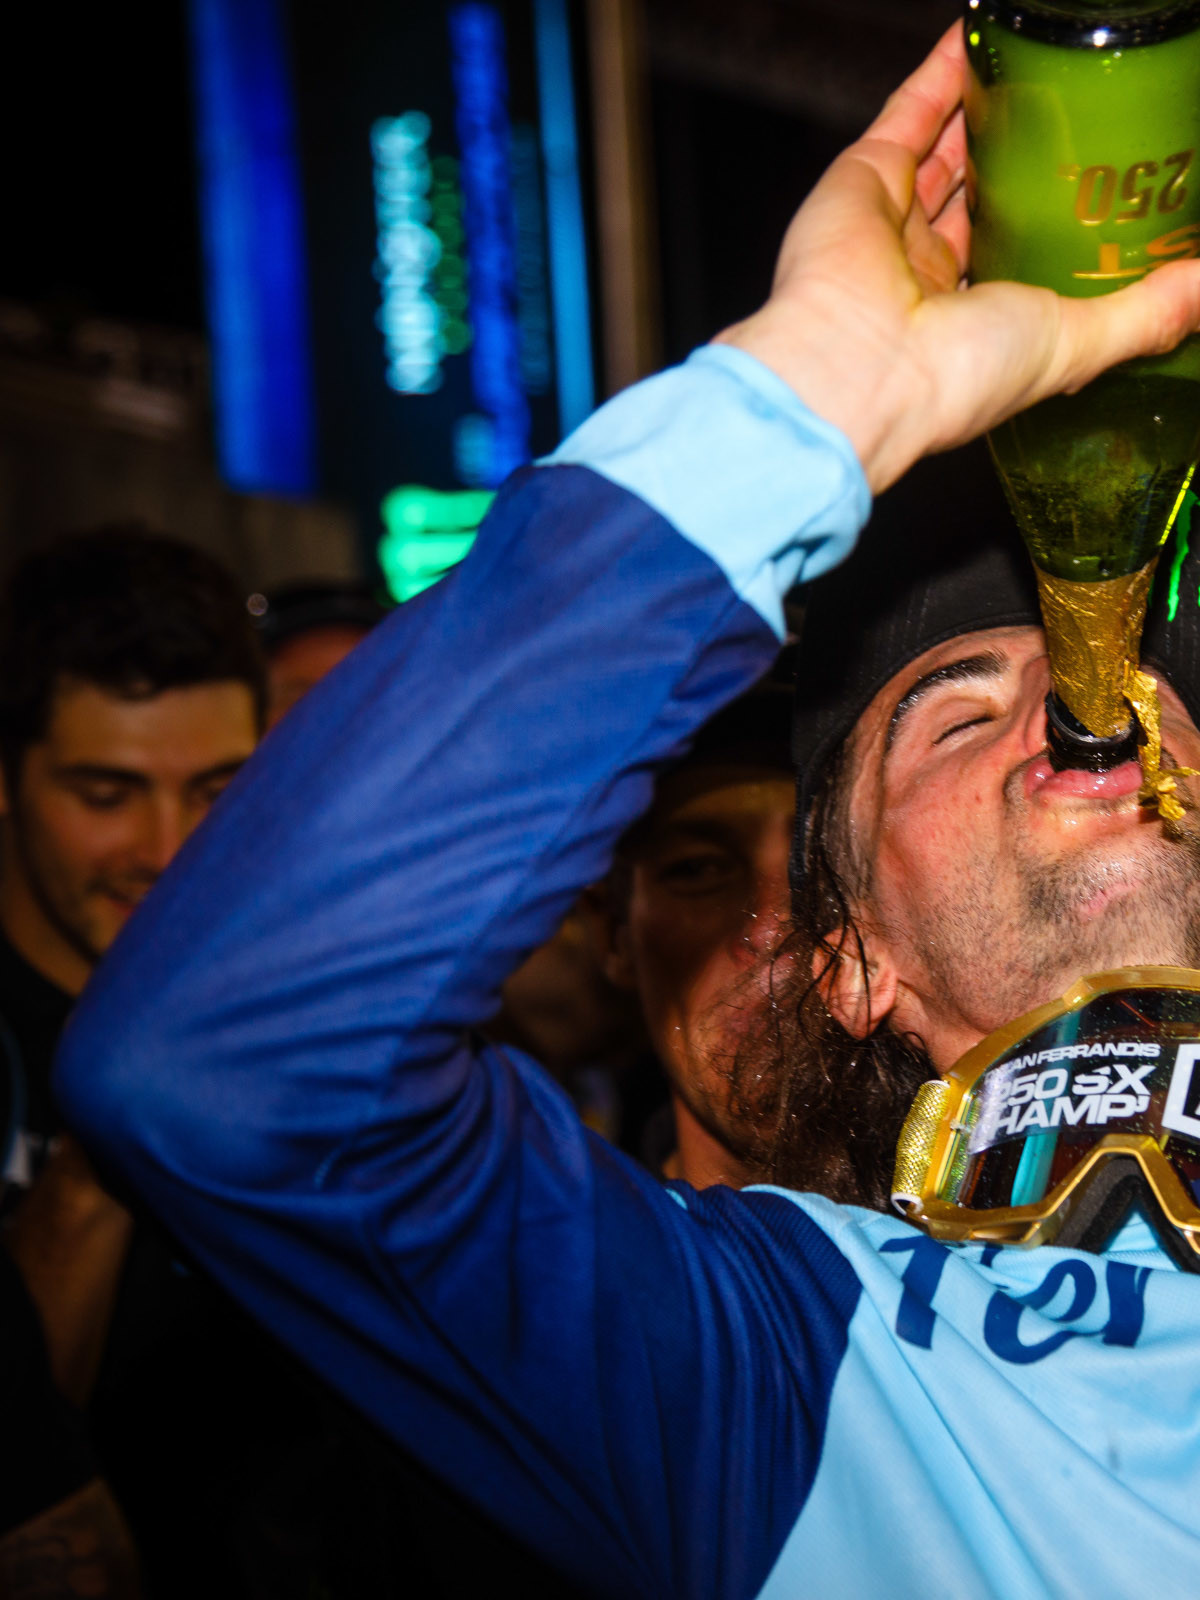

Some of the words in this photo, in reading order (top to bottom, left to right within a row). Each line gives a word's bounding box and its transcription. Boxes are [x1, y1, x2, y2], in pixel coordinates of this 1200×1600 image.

[1073, 149, 1196, 227] 250
[1037, 1043, 1162, 1065] FERRANDIS
[1072, 1064, 1157, 1096] SX
